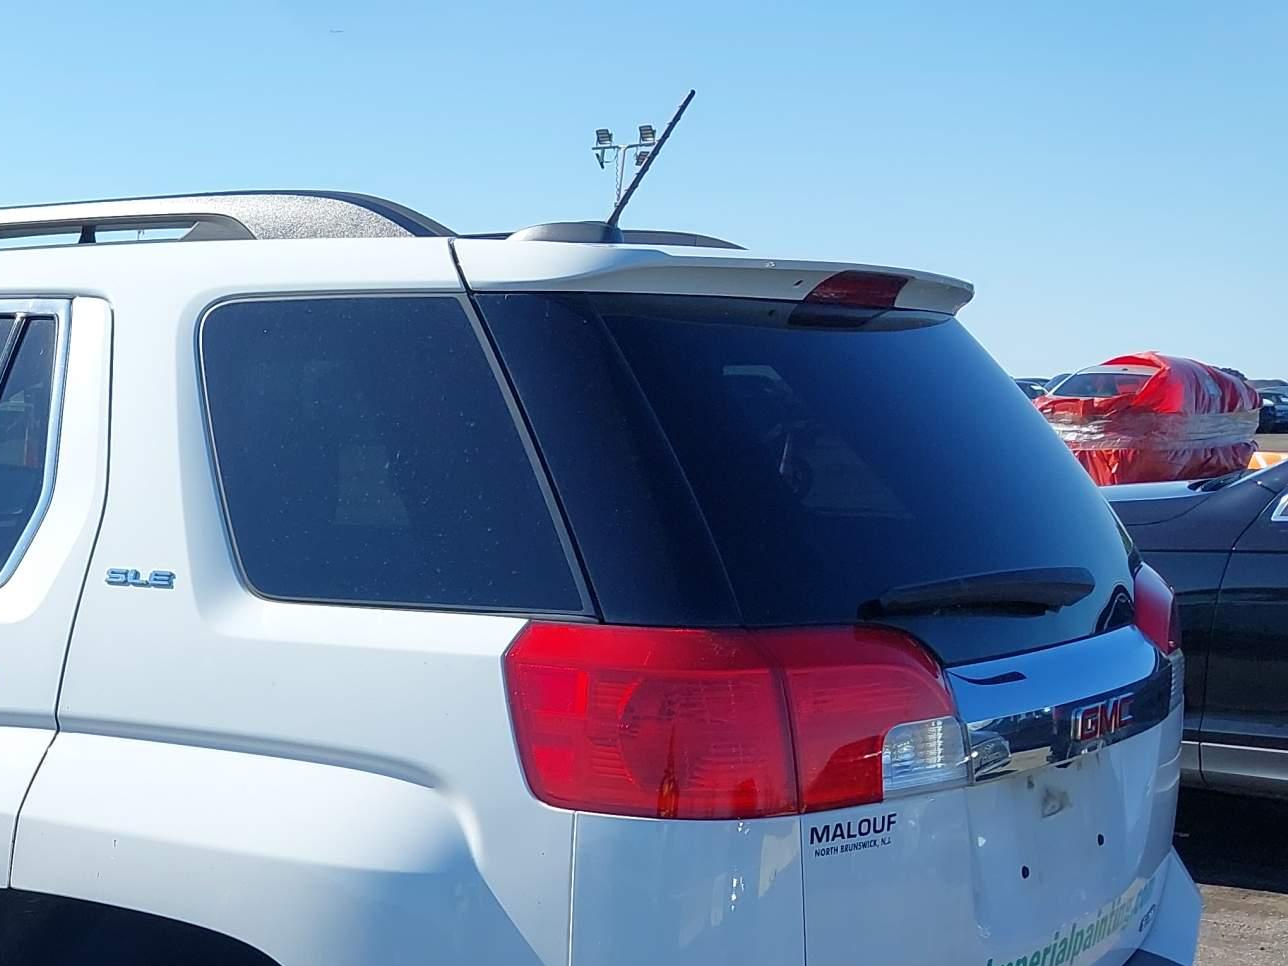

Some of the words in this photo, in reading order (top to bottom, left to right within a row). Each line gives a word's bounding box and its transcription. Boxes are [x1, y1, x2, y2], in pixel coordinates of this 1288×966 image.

[1071, 692, 1134, 742] GMC
[809, 813, 897, 845] MALOUF
[814, 845, 839, 858] NORTH
